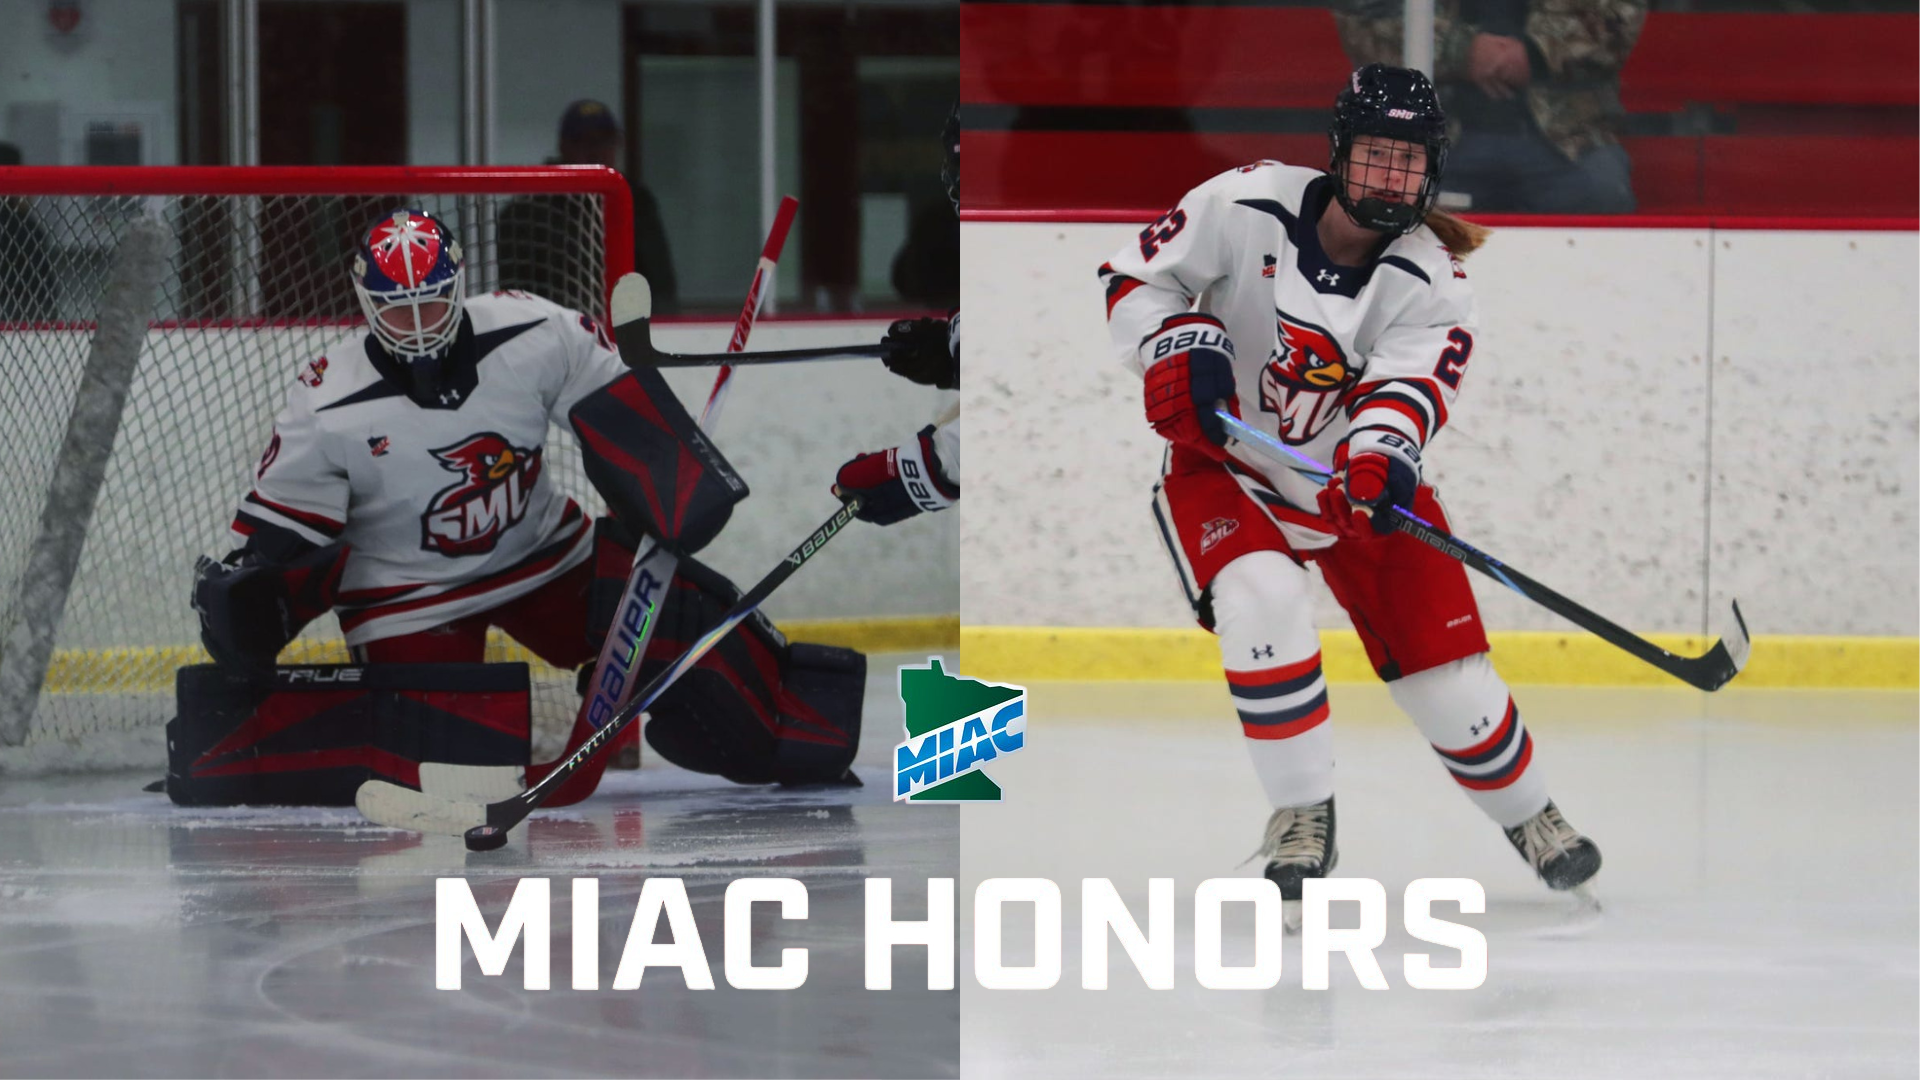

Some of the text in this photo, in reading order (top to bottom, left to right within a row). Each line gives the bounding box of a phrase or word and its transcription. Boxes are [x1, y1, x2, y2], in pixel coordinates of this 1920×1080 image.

[802, 499, 860, 559] BAUER
[277, 667, 364, 683] TRUE
[586, 567, 663, 731] BAUER
